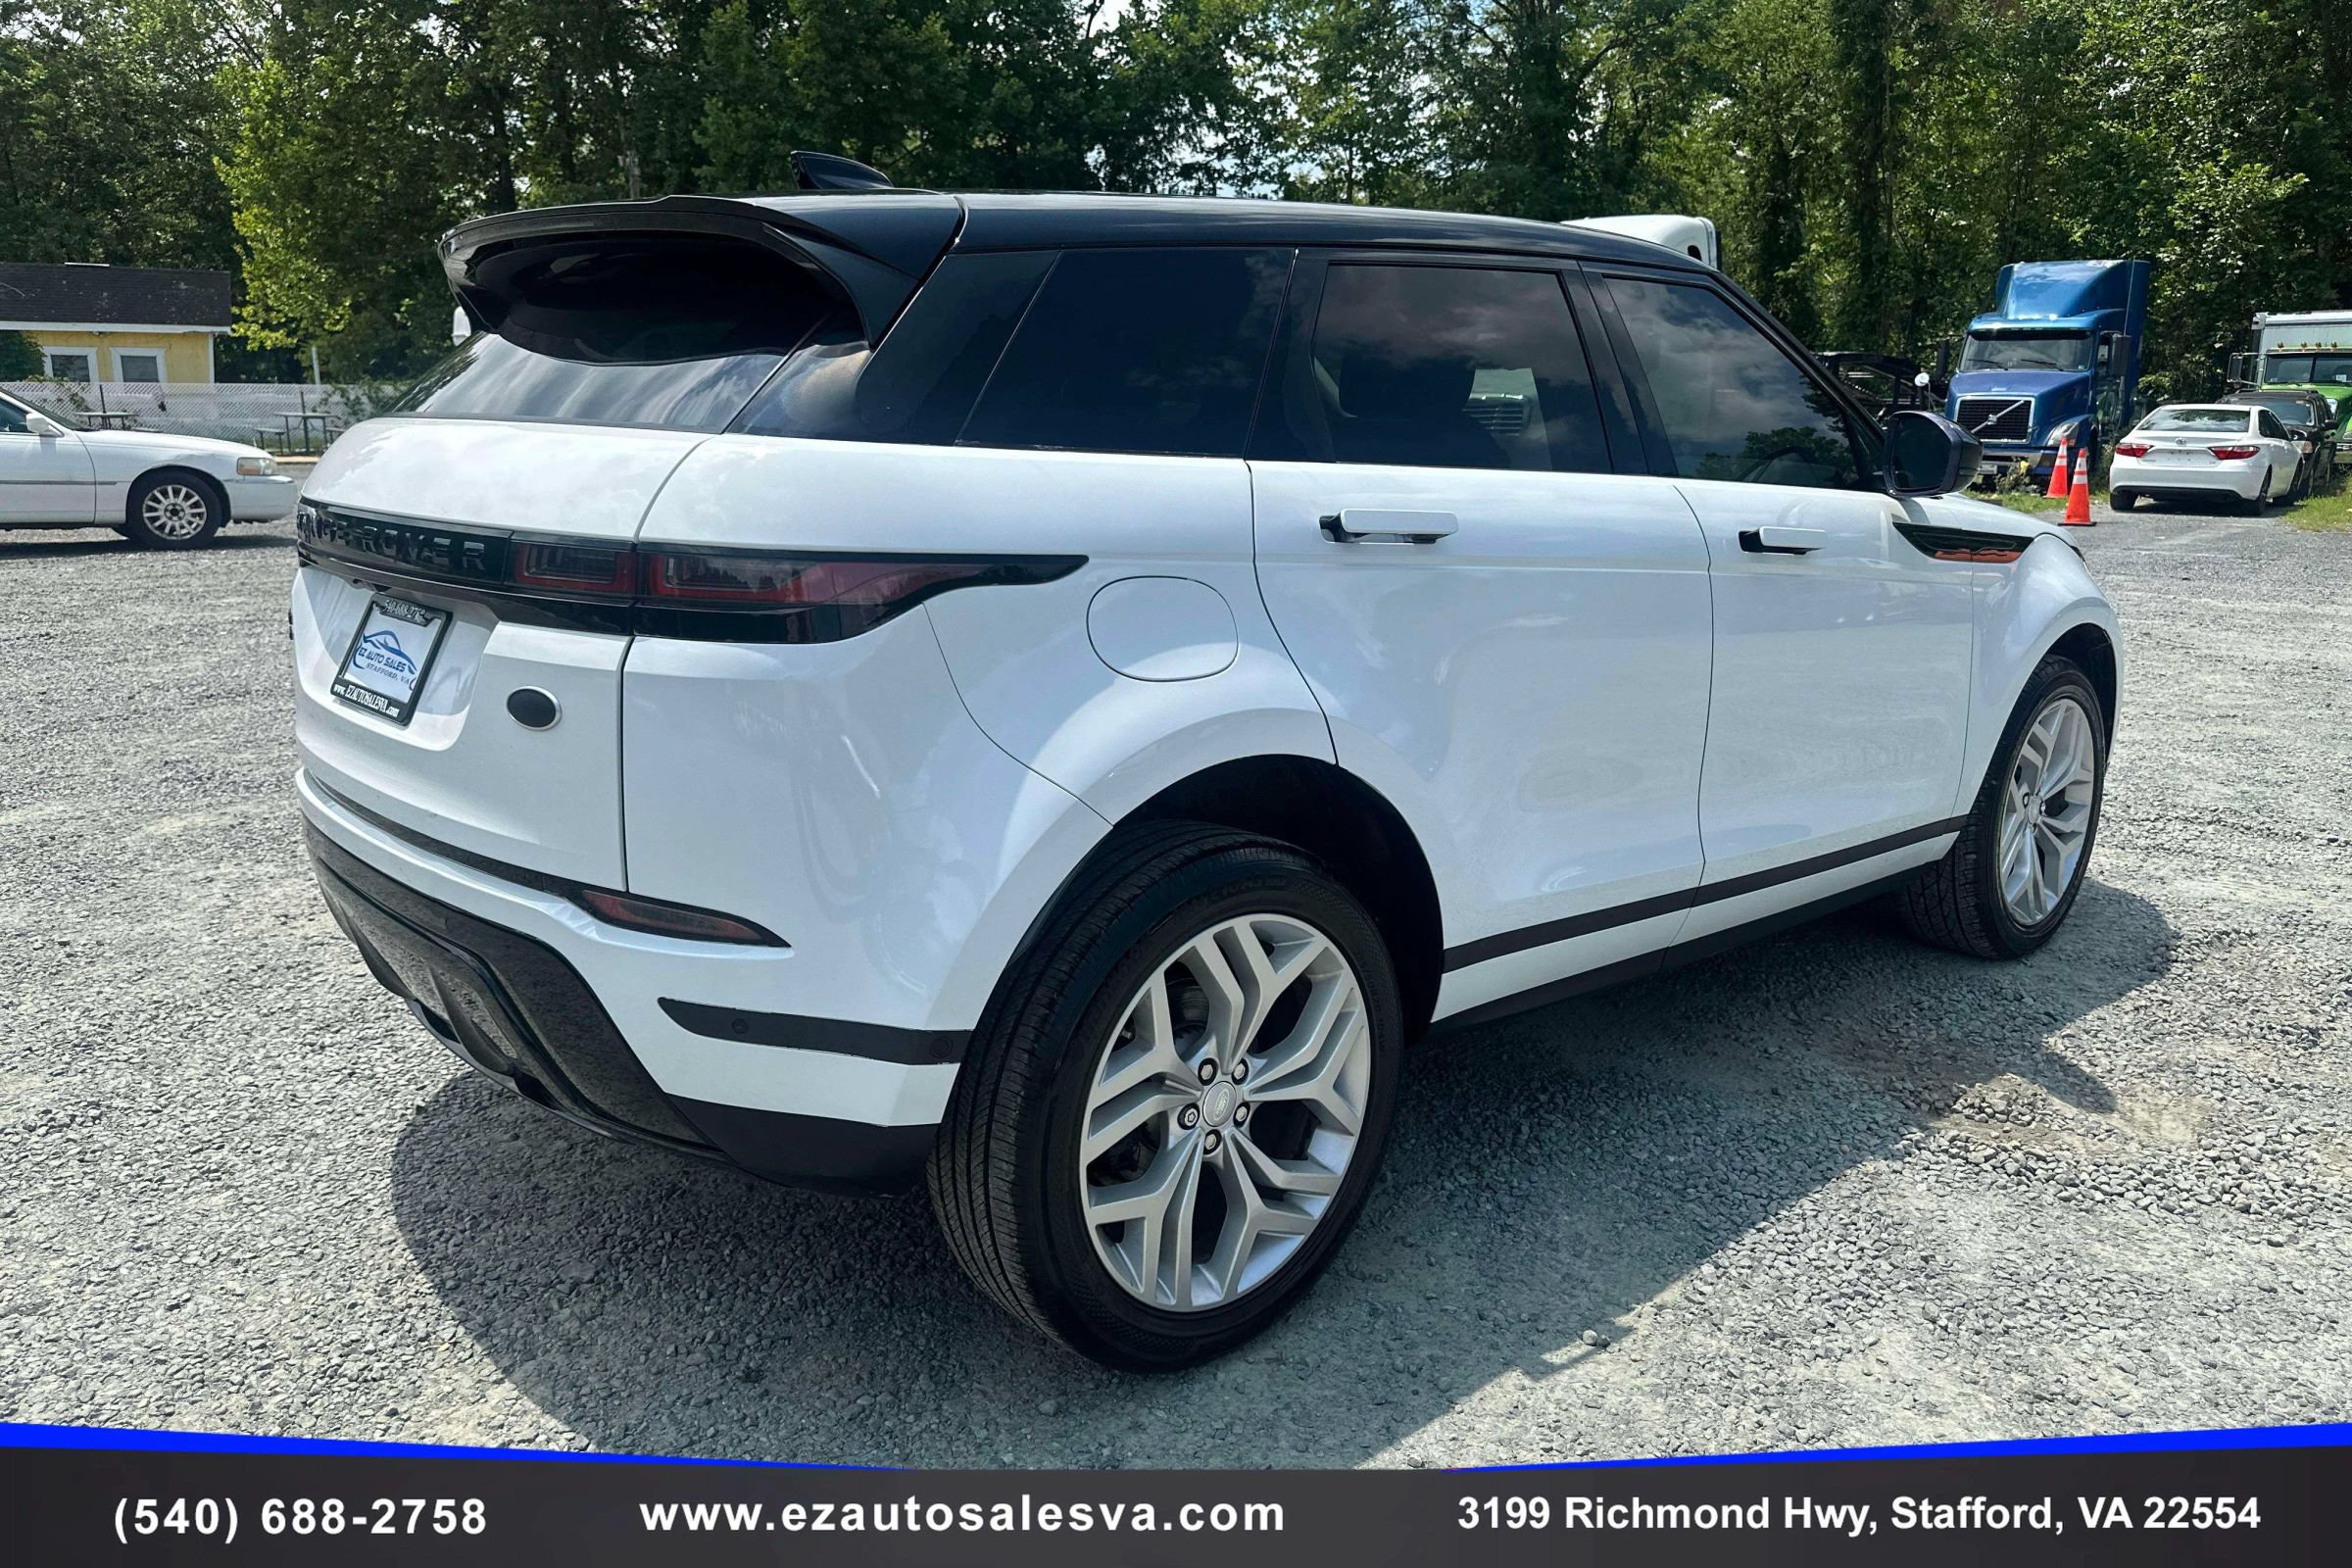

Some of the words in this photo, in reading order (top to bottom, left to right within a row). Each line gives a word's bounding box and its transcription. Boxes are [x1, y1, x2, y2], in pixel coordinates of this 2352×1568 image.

[362, 524, 487, 571] ROVER
[358, 647, 368, 657] EZ
[366, 651, 385, 664] AUTO
[383, 657, 407, 673] SALES
[366, 662, 399, 681] STAFFORD,
[400, 674, 411, 685] VA
